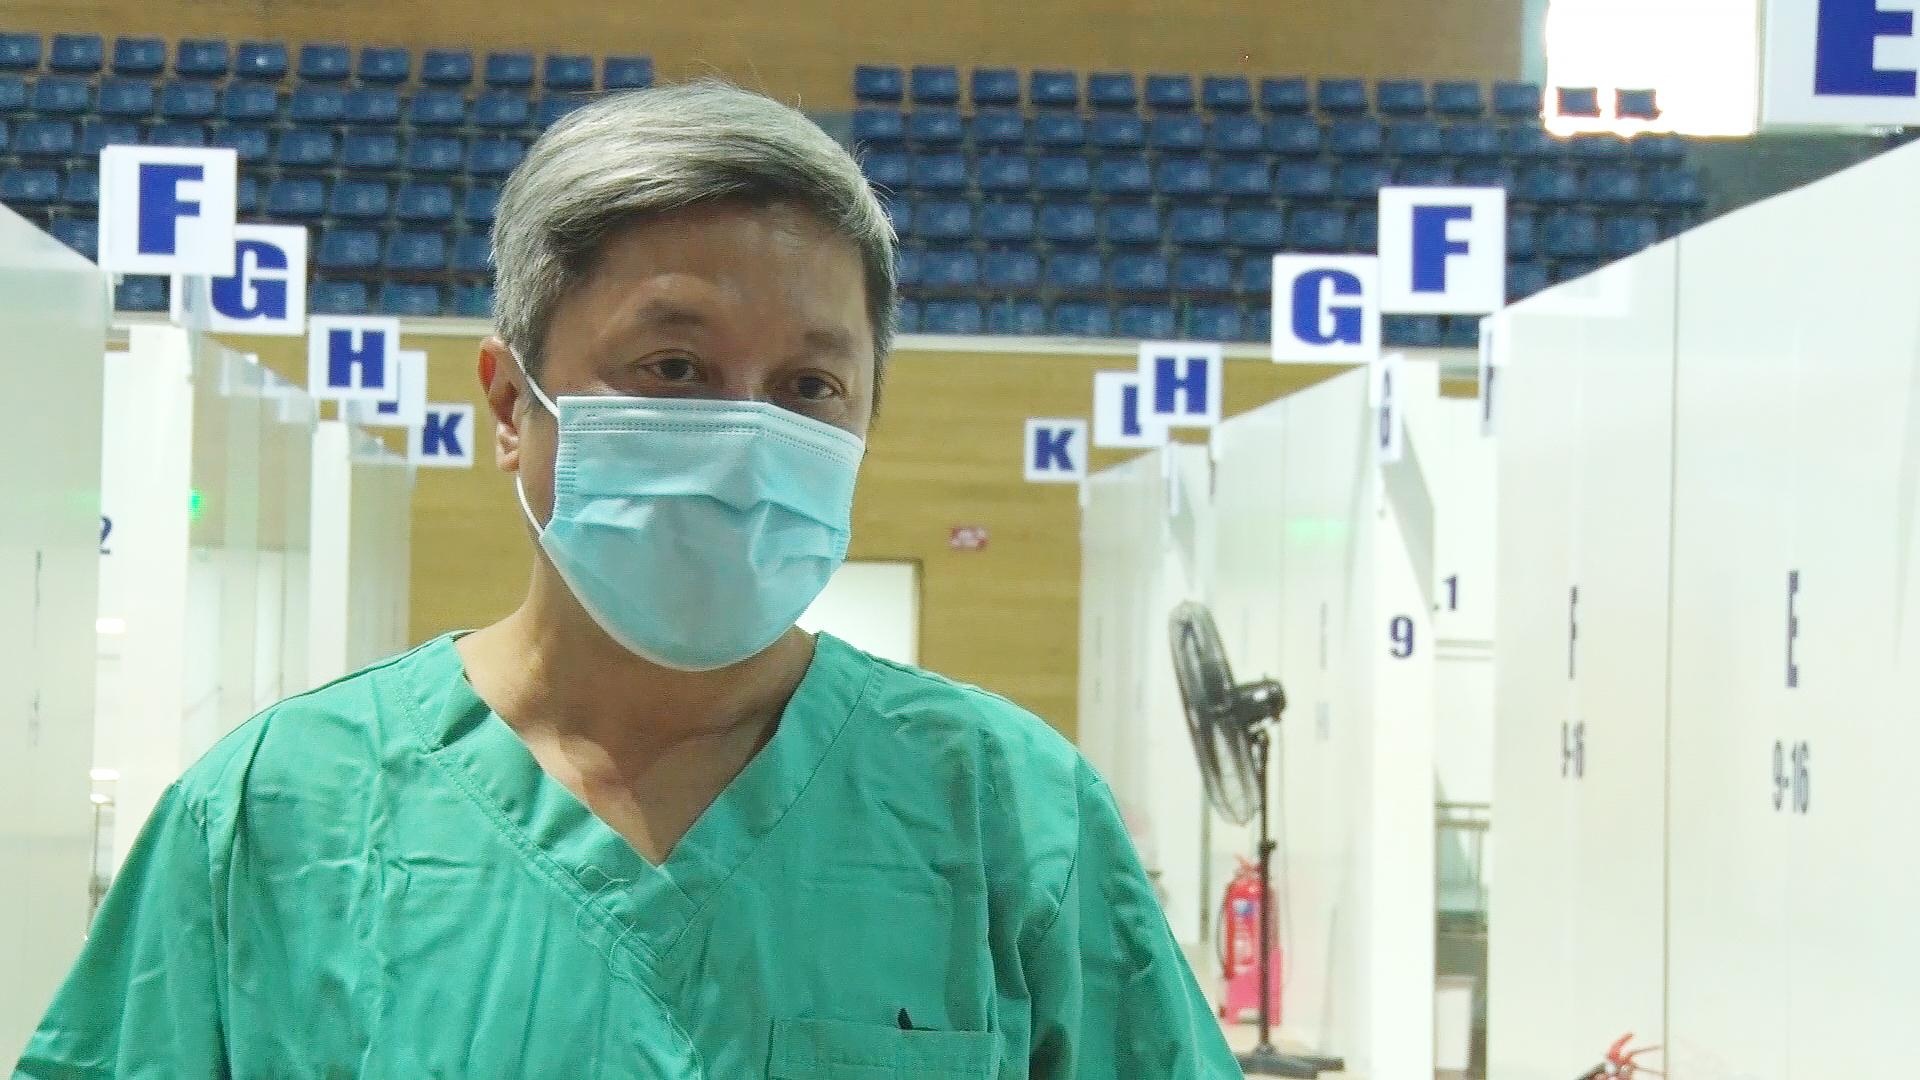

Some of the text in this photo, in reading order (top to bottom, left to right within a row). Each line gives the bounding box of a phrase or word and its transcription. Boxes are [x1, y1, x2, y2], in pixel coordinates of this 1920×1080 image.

[1815, 0, 1916, 96] E
[139, 163, 203, 255] F
[211, 240, 288, 320] G
[1412, 206, 1472, 292] F
[1292, 269, 1362, 345] G
[328, 329, 384, 388] H
[1155, 357, 1207, 415] H
[422, 412, 464, 456] K
[1035, 428, 1075, 471] K
[1390, 616, 1414, 659] 9
[1787, 569, 1799, 688] E
[1772, 739, 1809, 815] 9-16
